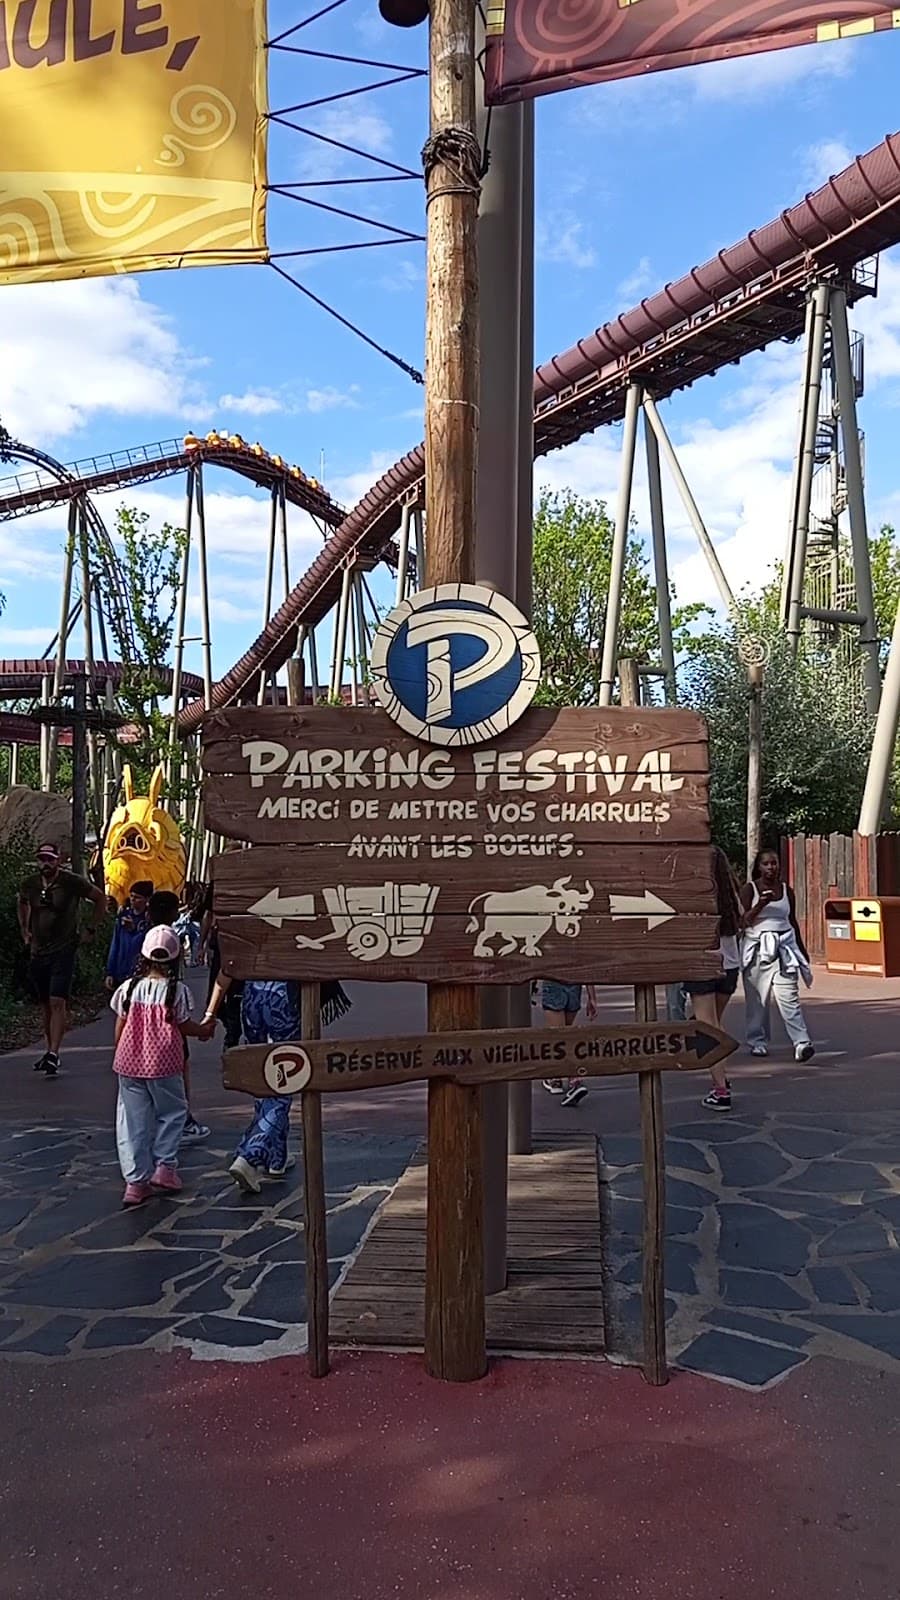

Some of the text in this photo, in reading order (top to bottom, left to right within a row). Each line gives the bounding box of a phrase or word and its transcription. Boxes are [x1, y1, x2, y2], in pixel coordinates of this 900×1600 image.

[350, 799, 379, 820] DE
[388, 799, 478, 820] METTRE
[486, 800, 536, 823] VOS
[544, 801, 671, 824] CHARRUES
[347, 833, 584, 859] AVANT LES BOEUFS.
[326, 1033, 682, 1074] RÉSERVÉ AUX VIEILLES CHARRUES
